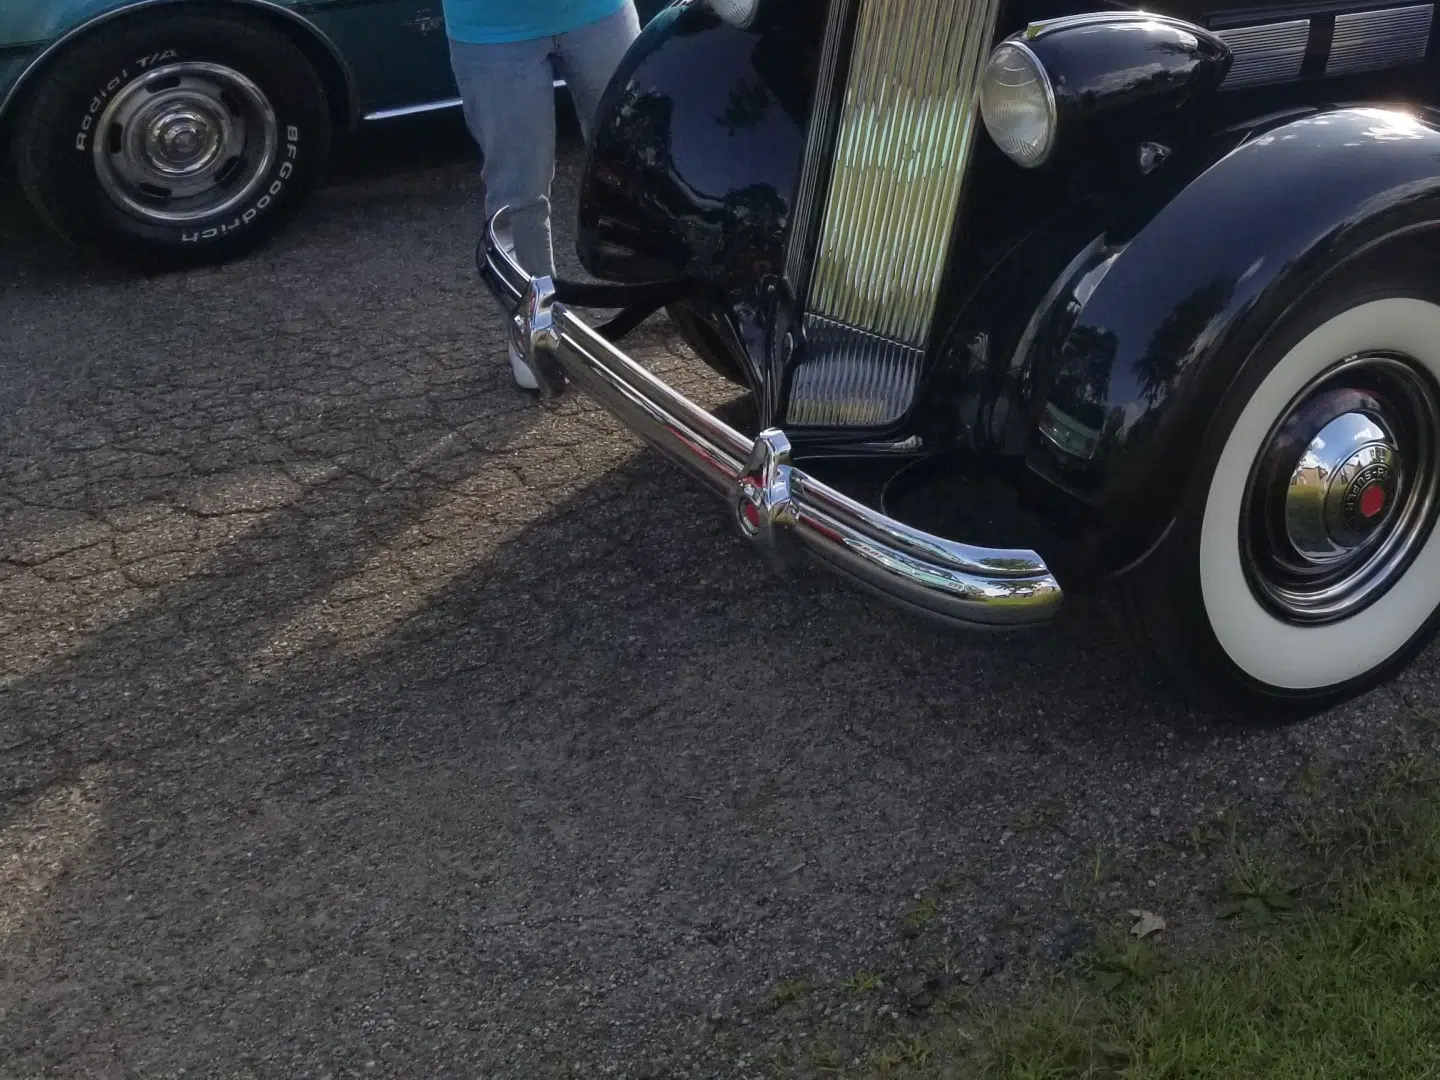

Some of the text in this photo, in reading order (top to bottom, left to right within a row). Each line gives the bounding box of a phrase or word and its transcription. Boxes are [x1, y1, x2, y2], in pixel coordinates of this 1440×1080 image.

[76, 48, 179, 152] Radial T/A
[181, 124, 299, 243] BFGoodrich
